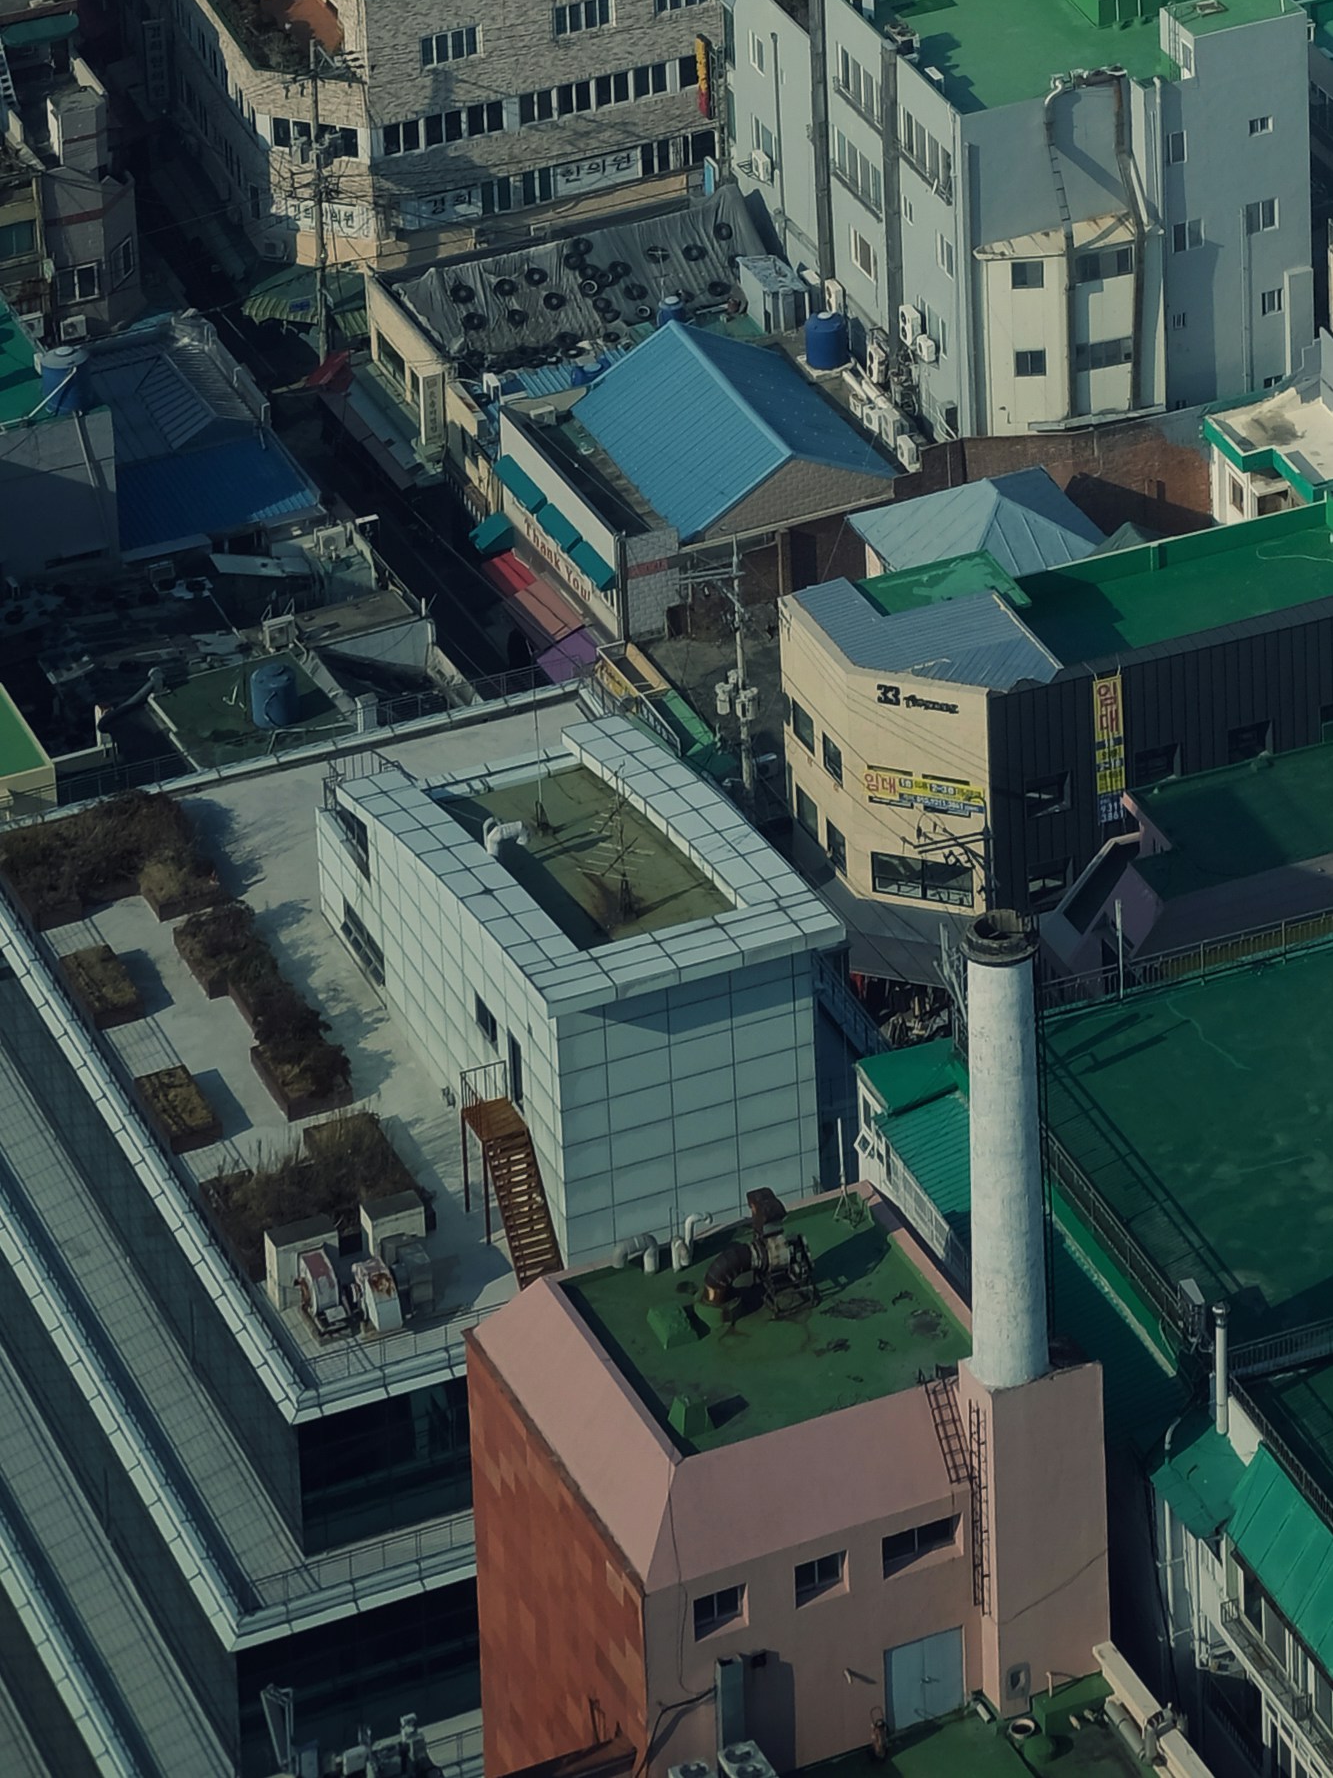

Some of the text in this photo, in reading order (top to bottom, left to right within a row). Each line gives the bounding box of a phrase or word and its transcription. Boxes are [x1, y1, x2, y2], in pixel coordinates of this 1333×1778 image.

[561, 153, 633, 184] 한의원
[524, 519, 591, 604] Thank You!
[877, 683, 901, 707] 33
[1096, 684, 1120, 733] 임대
[864, 773, 898, 794] 임대
